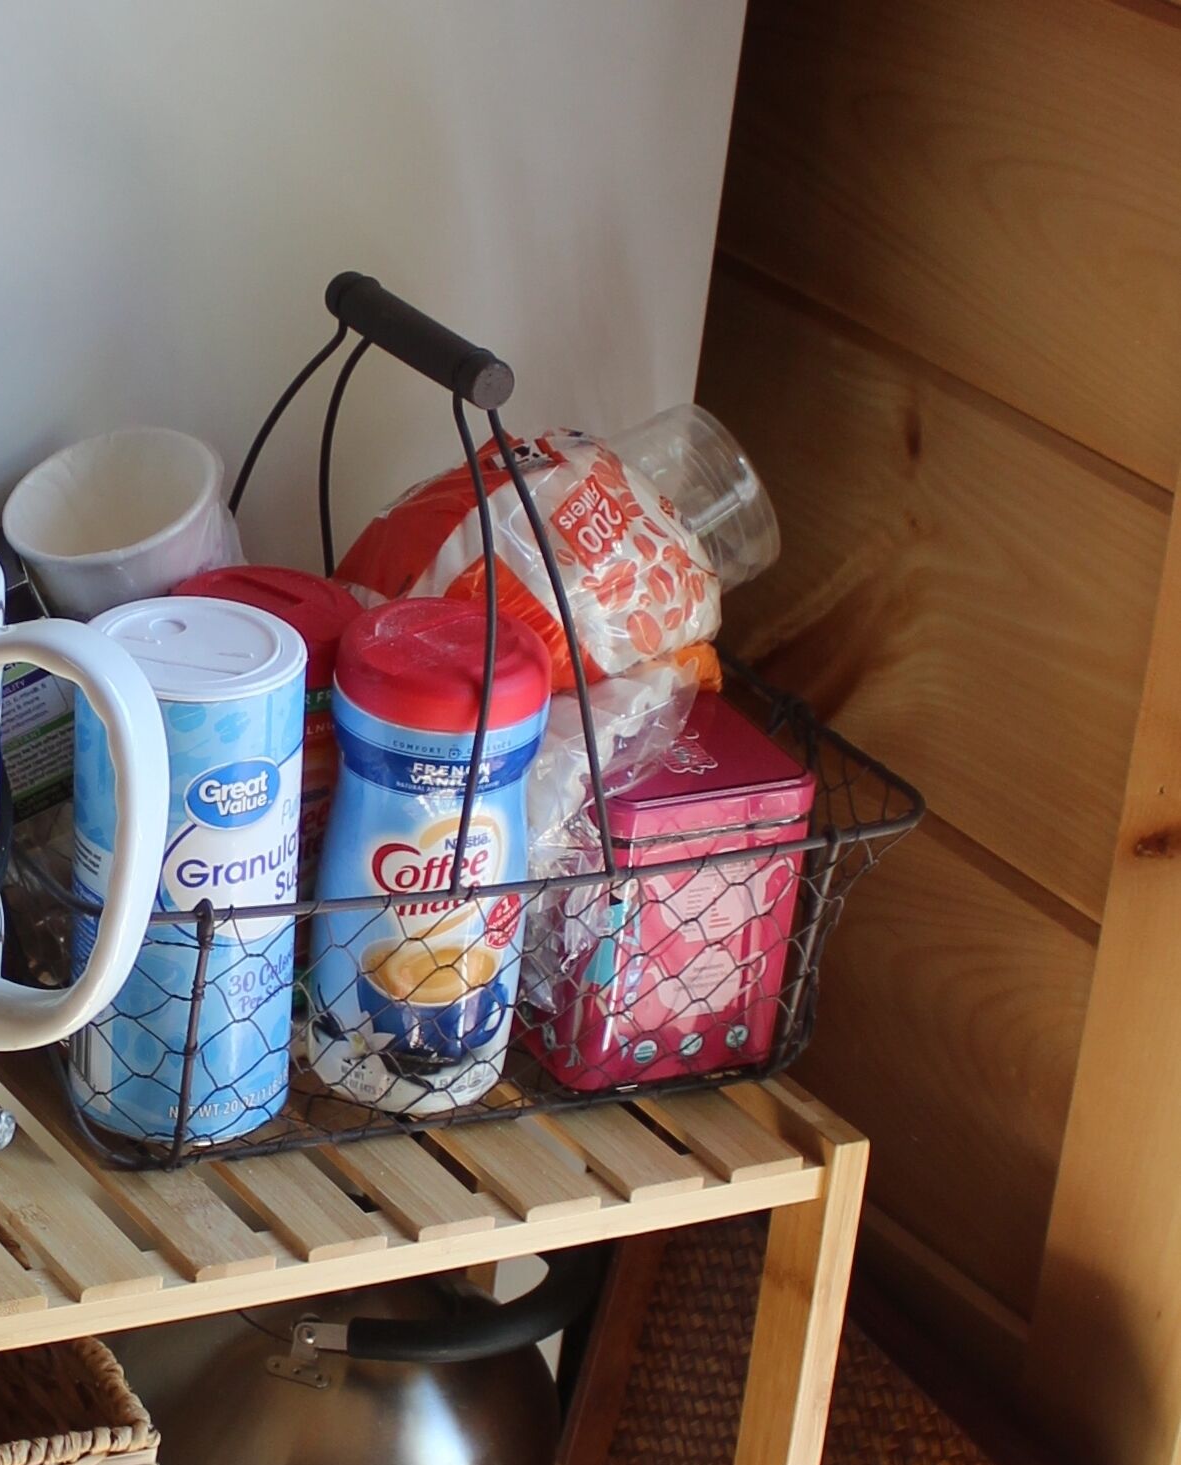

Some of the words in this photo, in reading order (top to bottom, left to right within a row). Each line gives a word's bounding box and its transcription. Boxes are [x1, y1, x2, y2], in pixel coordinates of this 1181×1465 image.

[558, 481, 601, 530] Filters
[577, 497, 623, 554] 200
[392, 740, 442, 754] COMFORT
[198, 770, 269, 804] Great
[410, 773, 491, 787] VANILA
[217, 793, 268, 817] Value
[371, 842, 489, 895] Coffee
[228, 971, 256, 997] 30
[169, 1104, 195, 1119] NT
[198, 1103, 220, 1118] WT
[222, 1100, 238, 1115] 20
